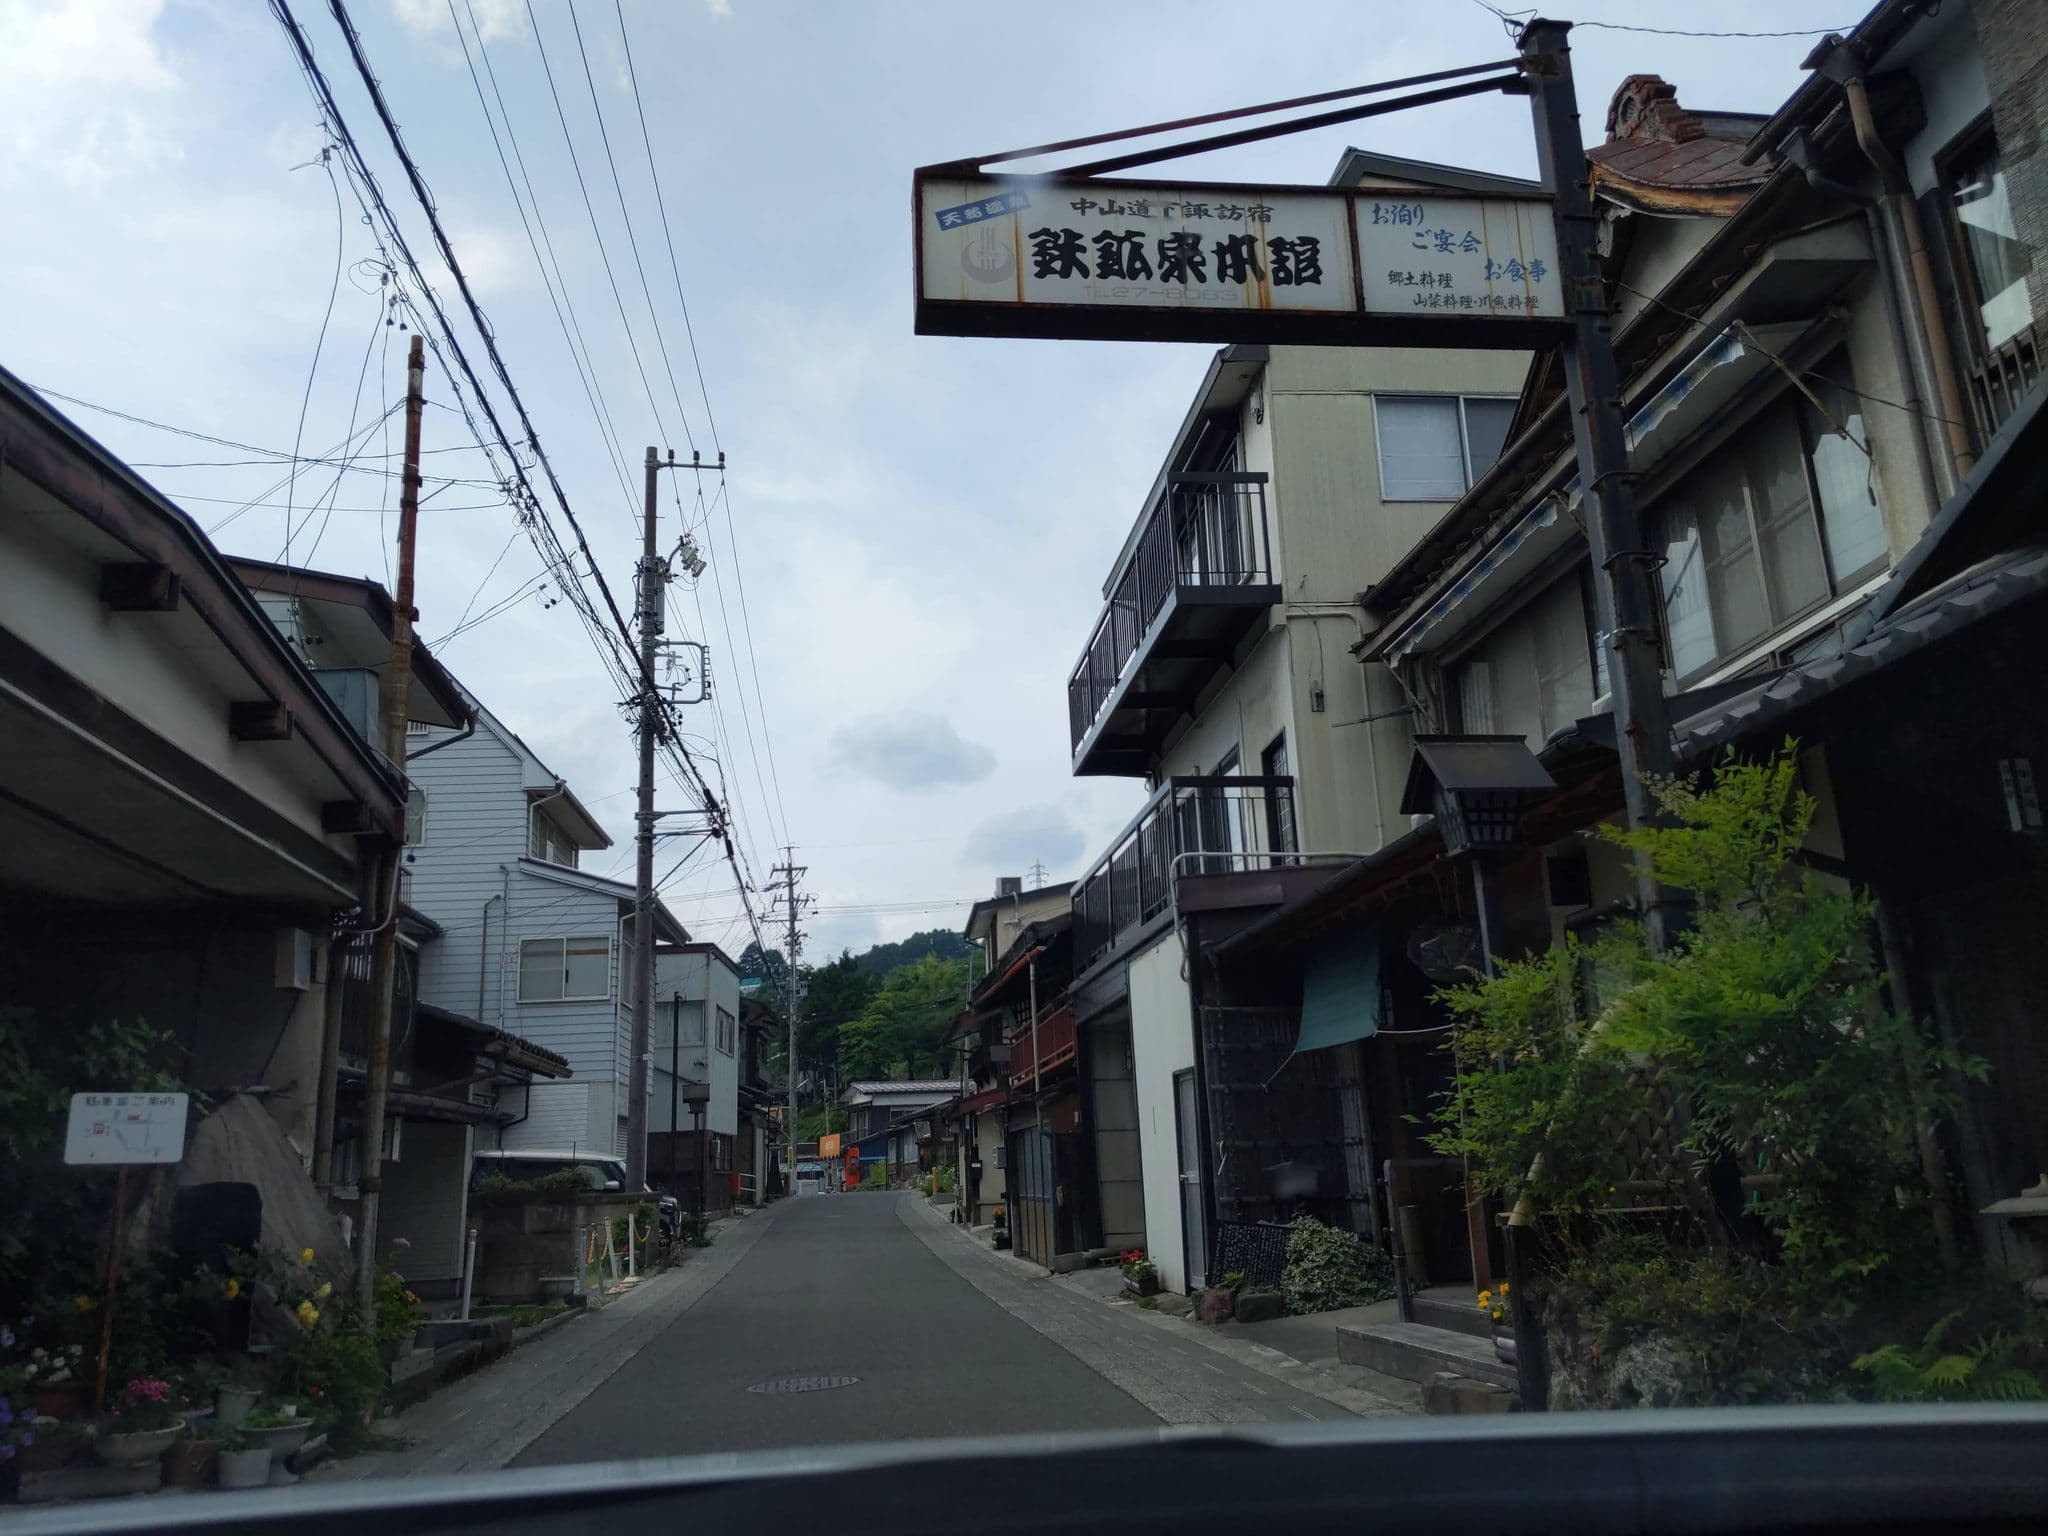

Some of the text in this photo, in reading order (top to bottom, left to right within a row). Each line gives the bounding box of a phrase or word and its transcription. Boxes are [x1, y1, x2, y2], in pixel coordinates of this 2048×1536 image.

[1372, 203, 1424, 226] お泊り
[1412, 230, 1483, 254] ご宴会
[1388, 269, 1453, 289] 郷土料理
[1484, 258, 1548, 283] お食事
